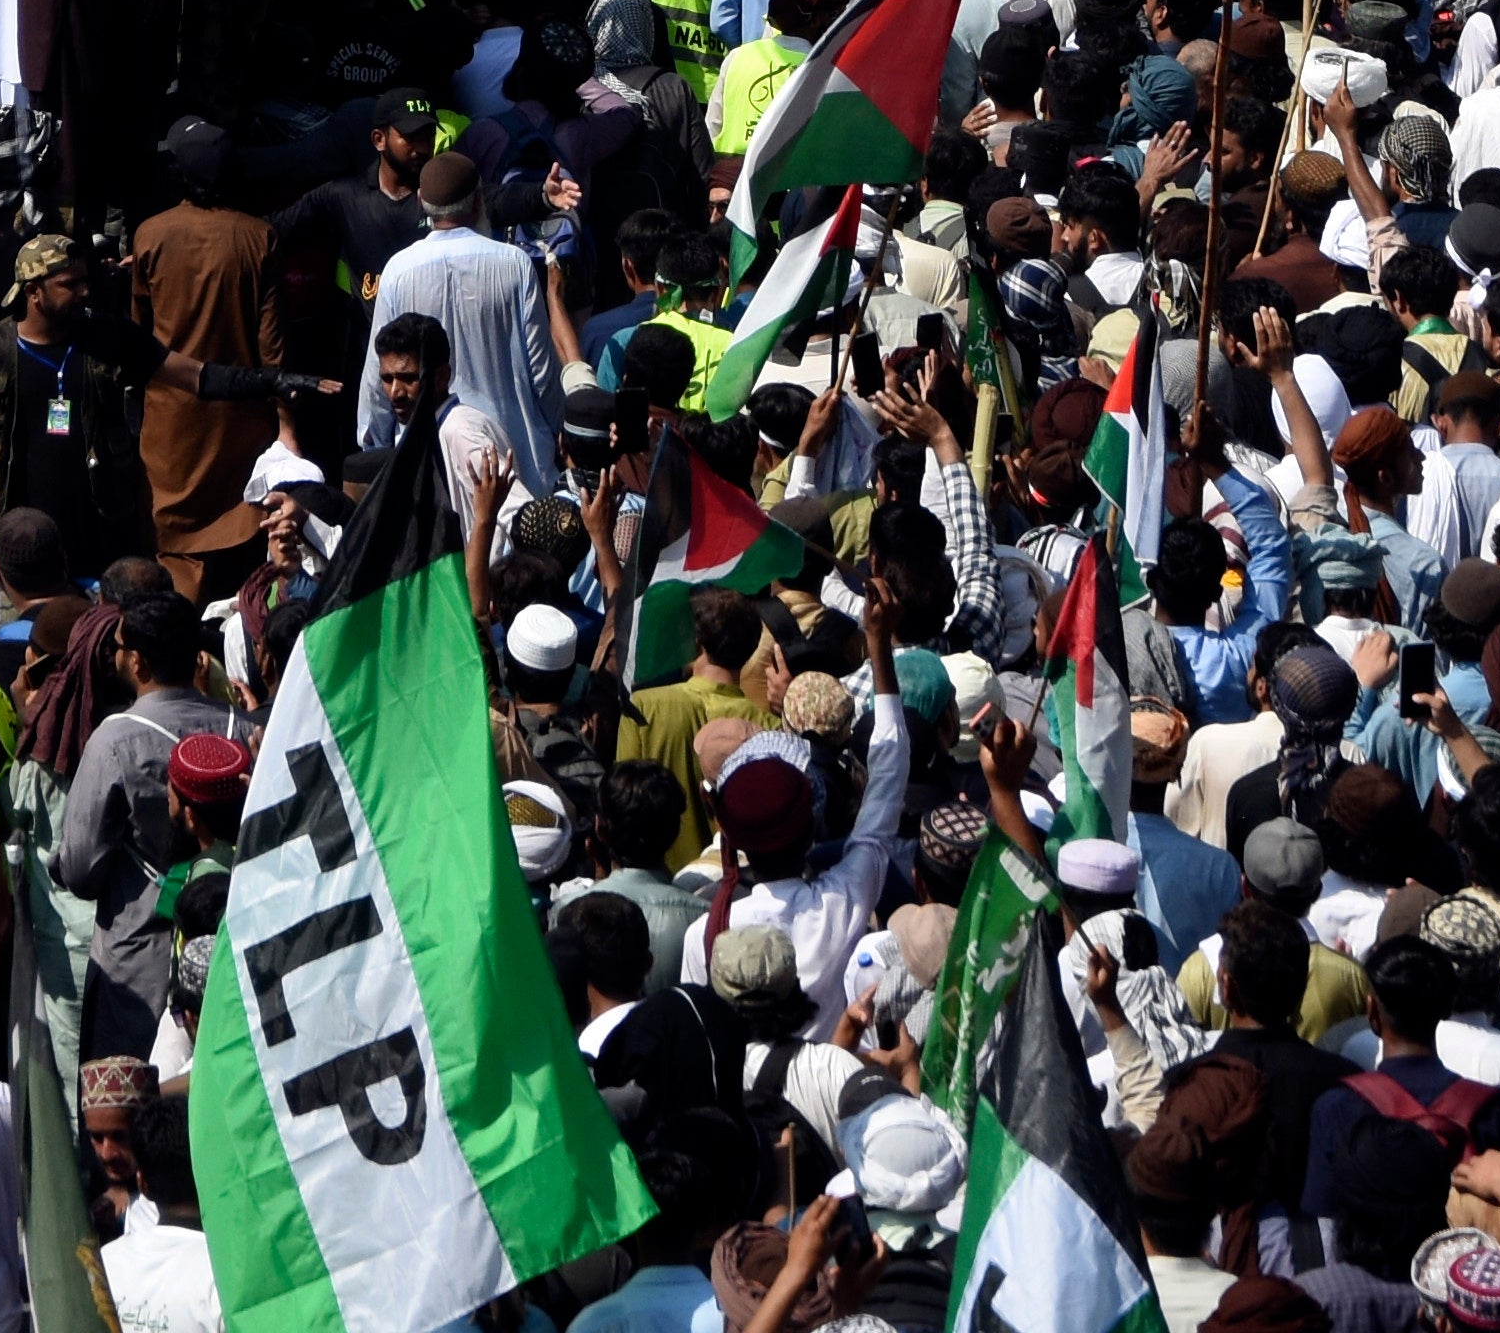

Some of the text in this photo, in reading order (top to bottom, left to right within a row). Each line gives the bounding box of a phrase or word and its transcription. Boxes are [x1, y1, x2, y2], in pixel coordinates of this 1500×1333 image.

[326, 42, 402, 78] SPECIAL SERV
[343, 65, 388, 84] GROUP
[232, 745, 428, 1167] TLP
